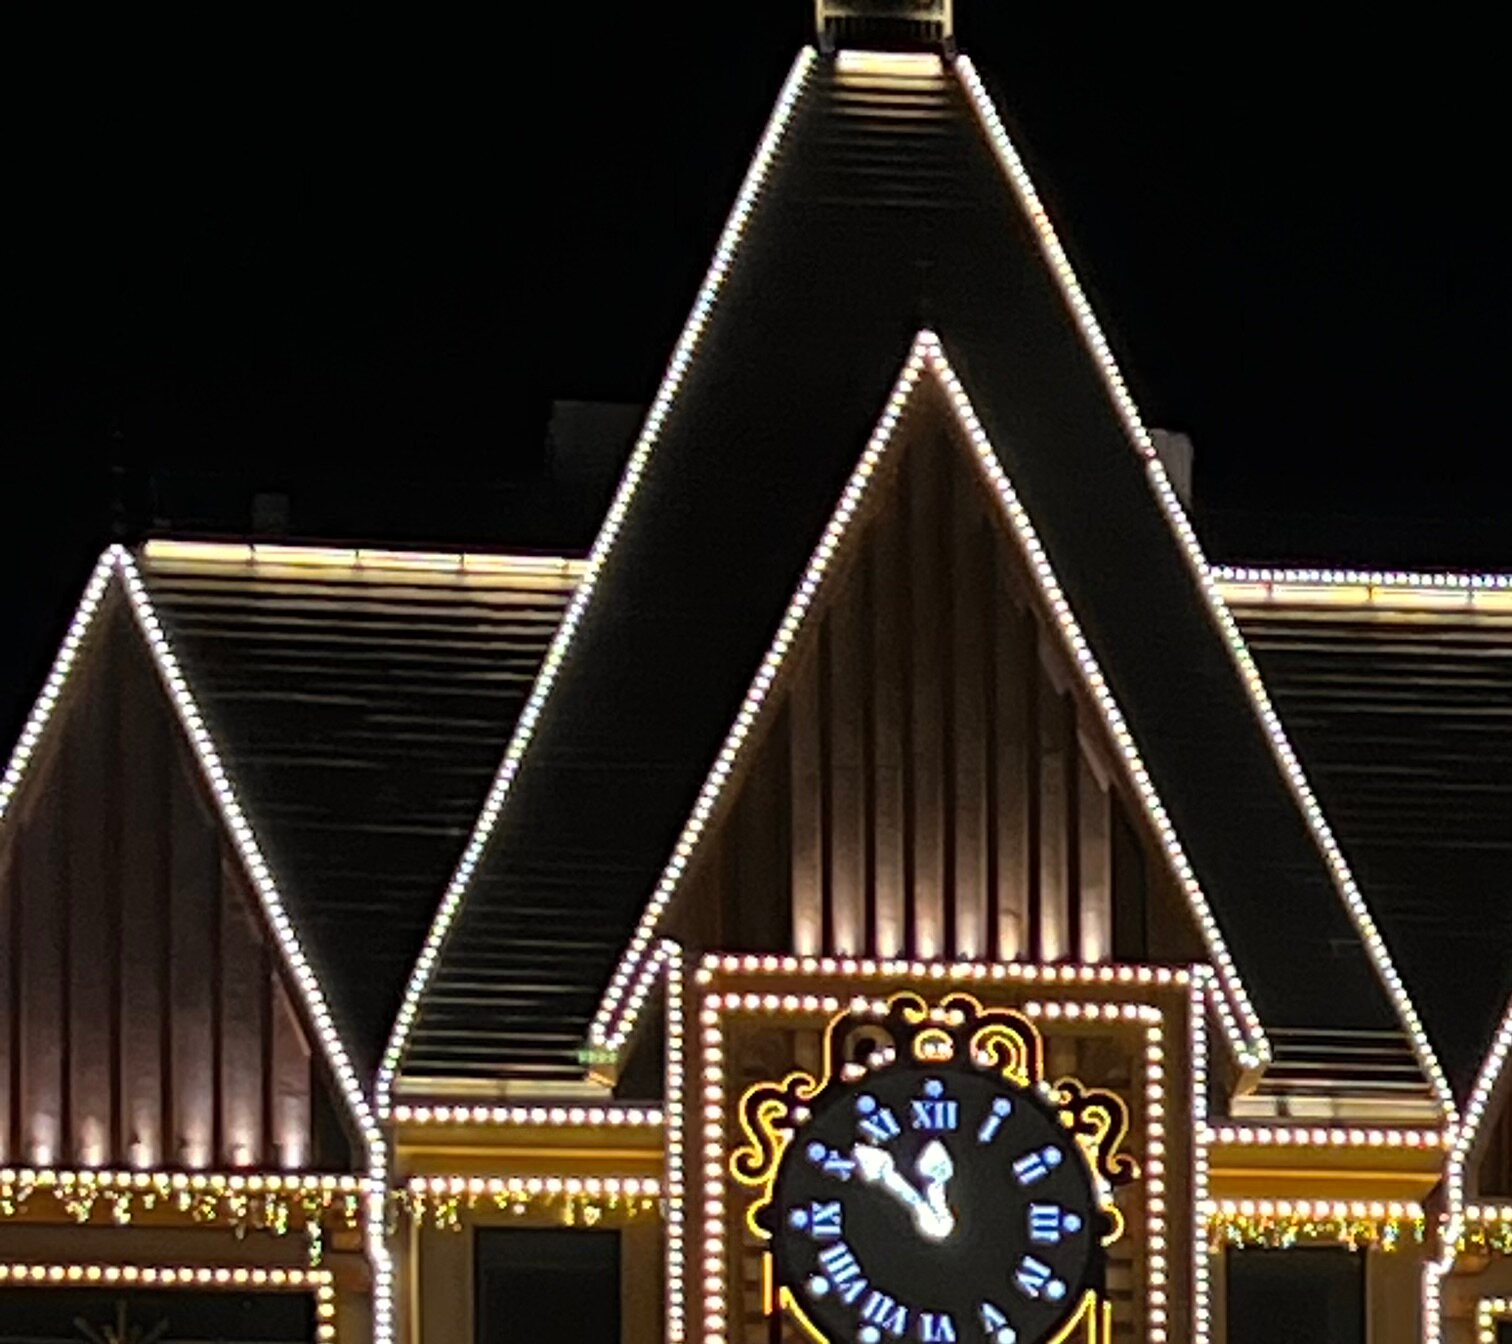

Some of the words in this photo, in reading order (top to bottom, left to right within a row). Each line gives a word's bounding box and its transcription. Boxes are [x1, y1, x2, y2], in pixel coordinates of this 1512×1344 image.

[911, 1100, 958, 1129] XII
[1029, 1203, 1060, 1241] III
[819, 1241, 868, 1304] VIII
[862, 1291, 908, 1335] VII
[920, 1313, 956, 1342] VI
